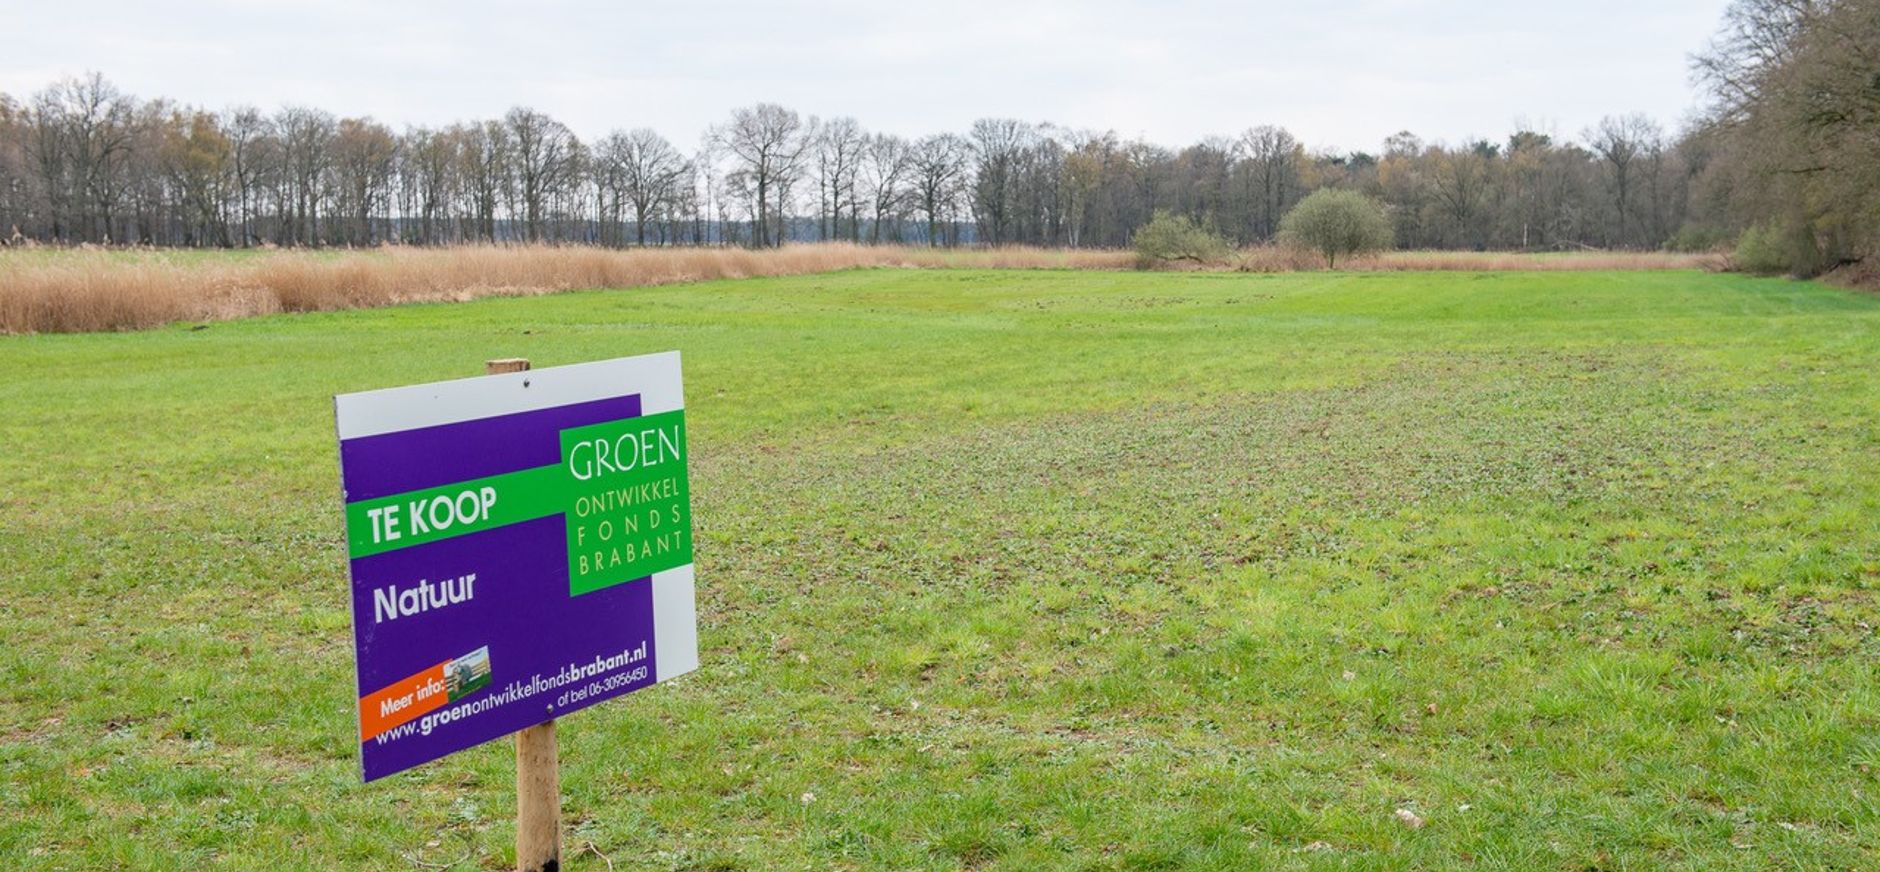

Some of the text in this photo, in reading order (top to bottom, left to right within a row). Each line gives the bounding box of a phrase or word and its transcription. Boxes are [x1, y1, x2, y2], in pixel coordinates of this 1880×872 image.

[569, 425, 680, 481] GROEN
[367, 486, 497, 543] TE KOOP
[575, 478, 679, 517] ONTWIKKEL
[579, 530, 682, 575] BRABANT
[373, 573, 476, 623] Natuur
[375, 640, 647, 745] www.groenontwikkelfondsbrabant.nl
[380, 695, 413, 718] Meer
[416, 677, 445, 701] info:
[557, 666, 647, 707] of bel 06-30956450
